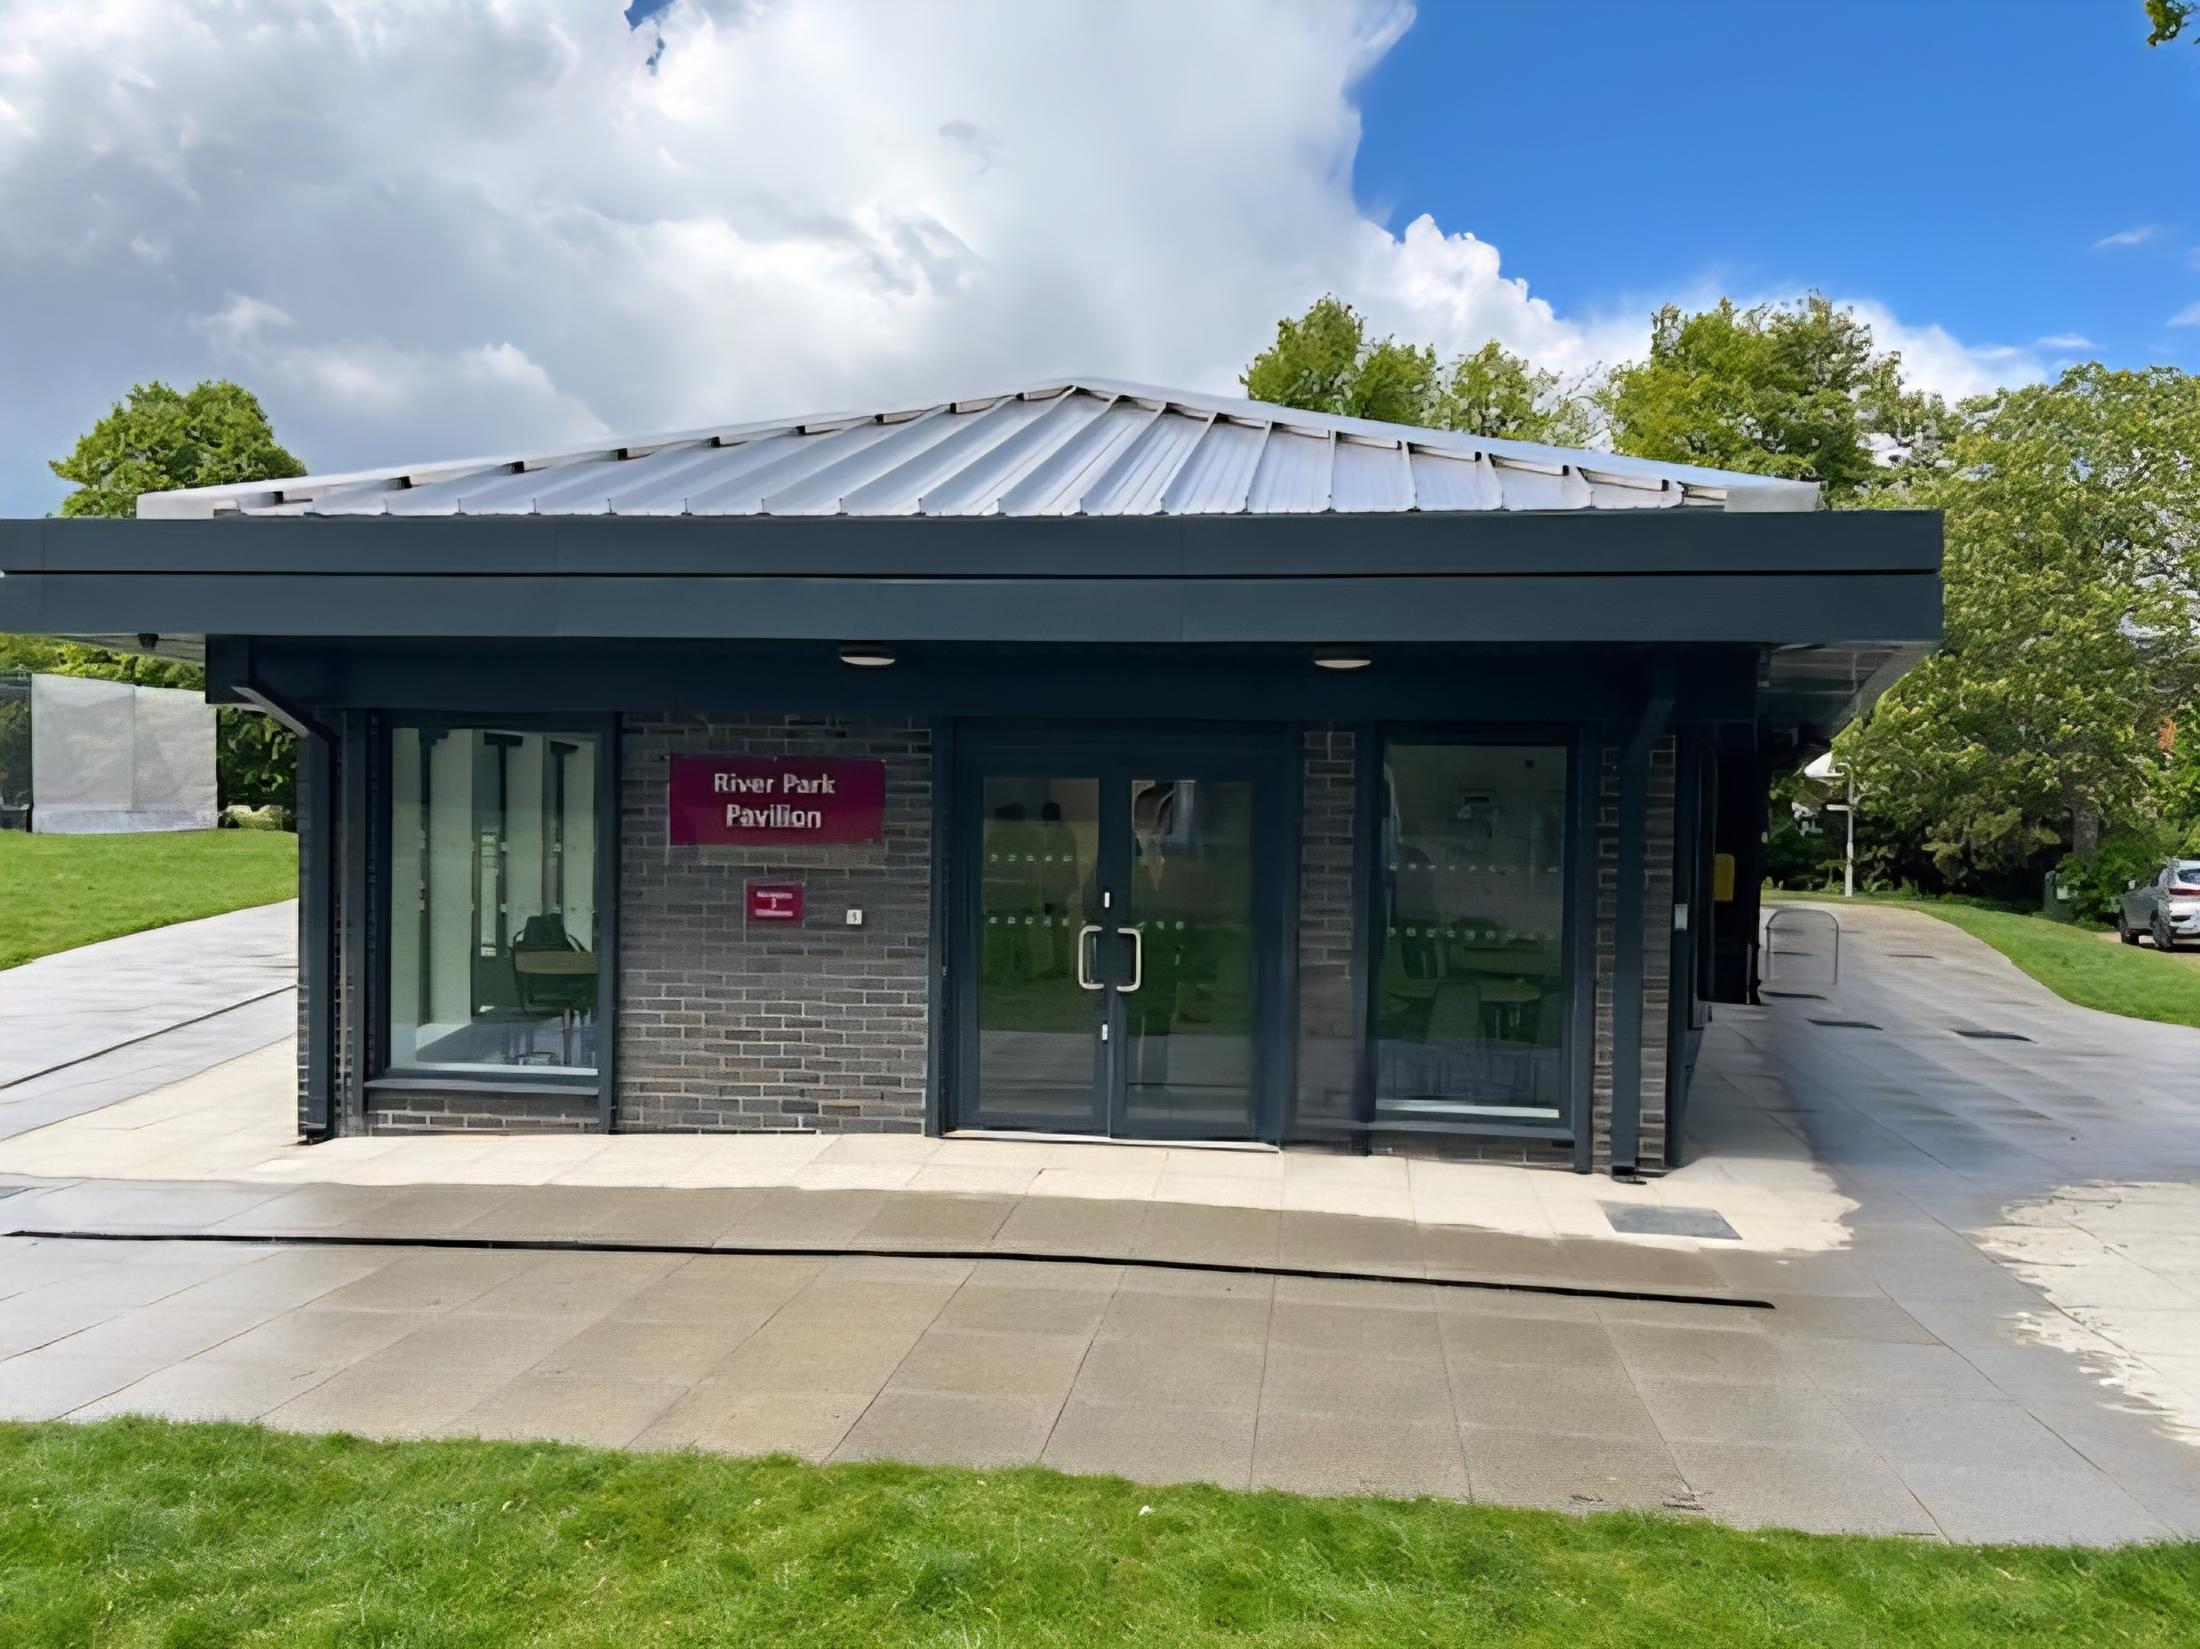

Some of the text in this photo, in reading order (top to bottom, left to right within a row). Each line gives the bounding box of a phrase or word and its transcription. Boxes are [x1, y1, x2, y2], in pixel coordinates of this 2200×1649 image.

[714, 773, 836, 794] River Park
[726, 804, 821, 828] Pavilion
